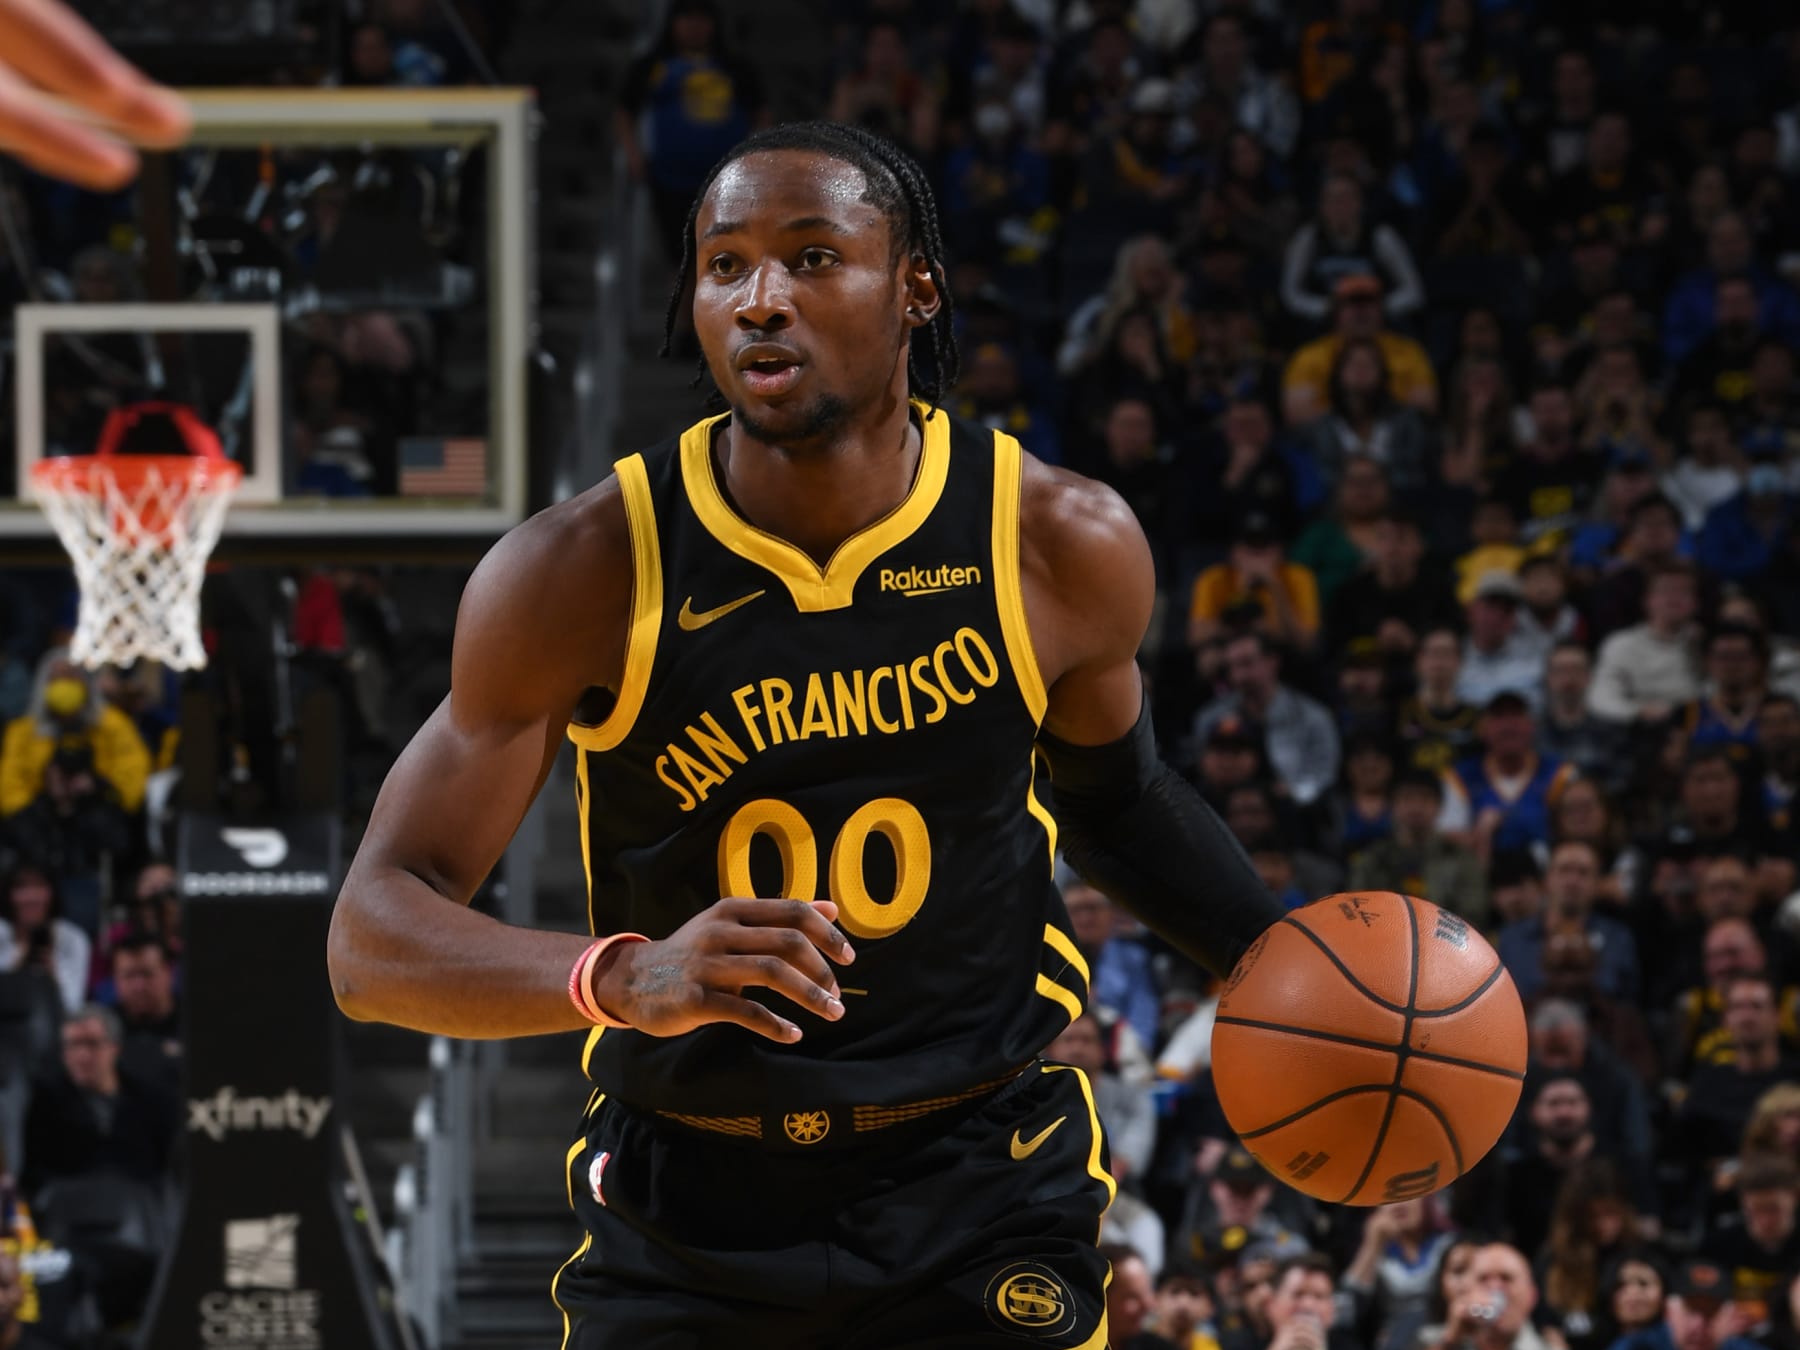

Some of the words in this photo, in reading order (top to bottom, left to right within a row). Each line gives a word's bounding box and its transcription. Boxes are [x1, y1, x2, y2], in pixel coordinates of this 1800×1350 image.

[880, 564, 982, 598] Rakuten
[656, 711, 750, 812] SAN
[731, 627, 999, 752] FRANCISCO
[717, 797, 931, 939] 00
[187, 1086, 333, 1140] xfinity
